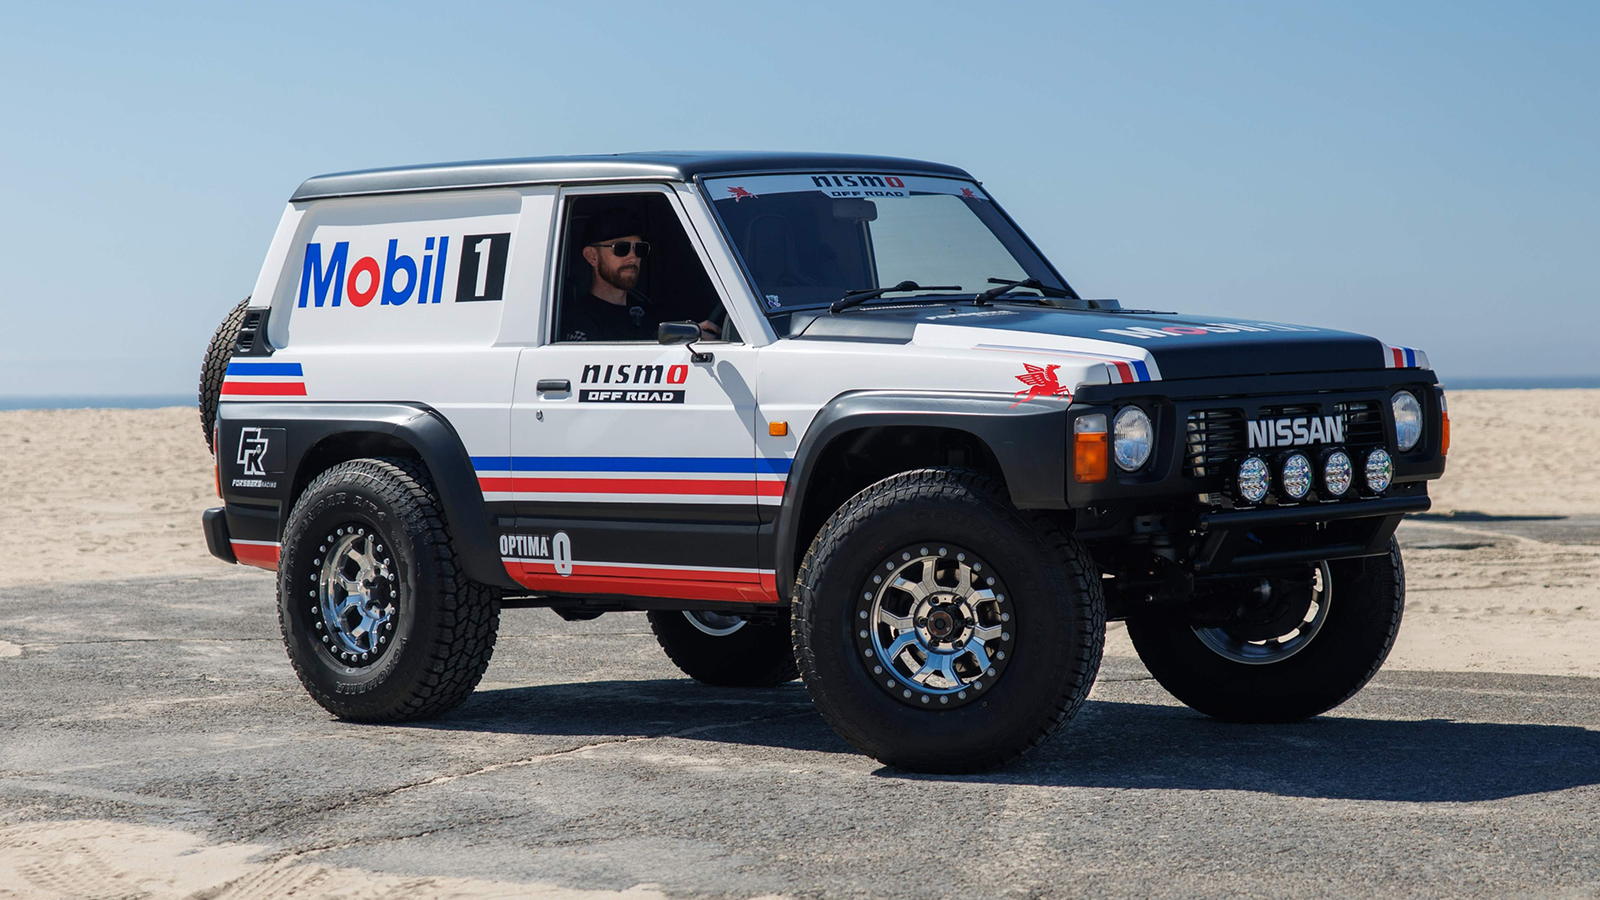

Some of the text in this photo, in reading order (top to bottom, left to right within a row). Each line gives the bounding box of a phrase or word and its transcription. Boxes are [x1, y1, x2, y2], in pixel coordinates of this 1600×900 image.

[811, 176, 905, 188] nismo
[298, 236, 491, 308] Mobil 1
[580, 365, 688, 384] nismo
[588, 391, 674, 401] OFF ROAD
[1248, 416, 1343, 448] NISSAN
[500, 534, 549, 557] OPTIMA
